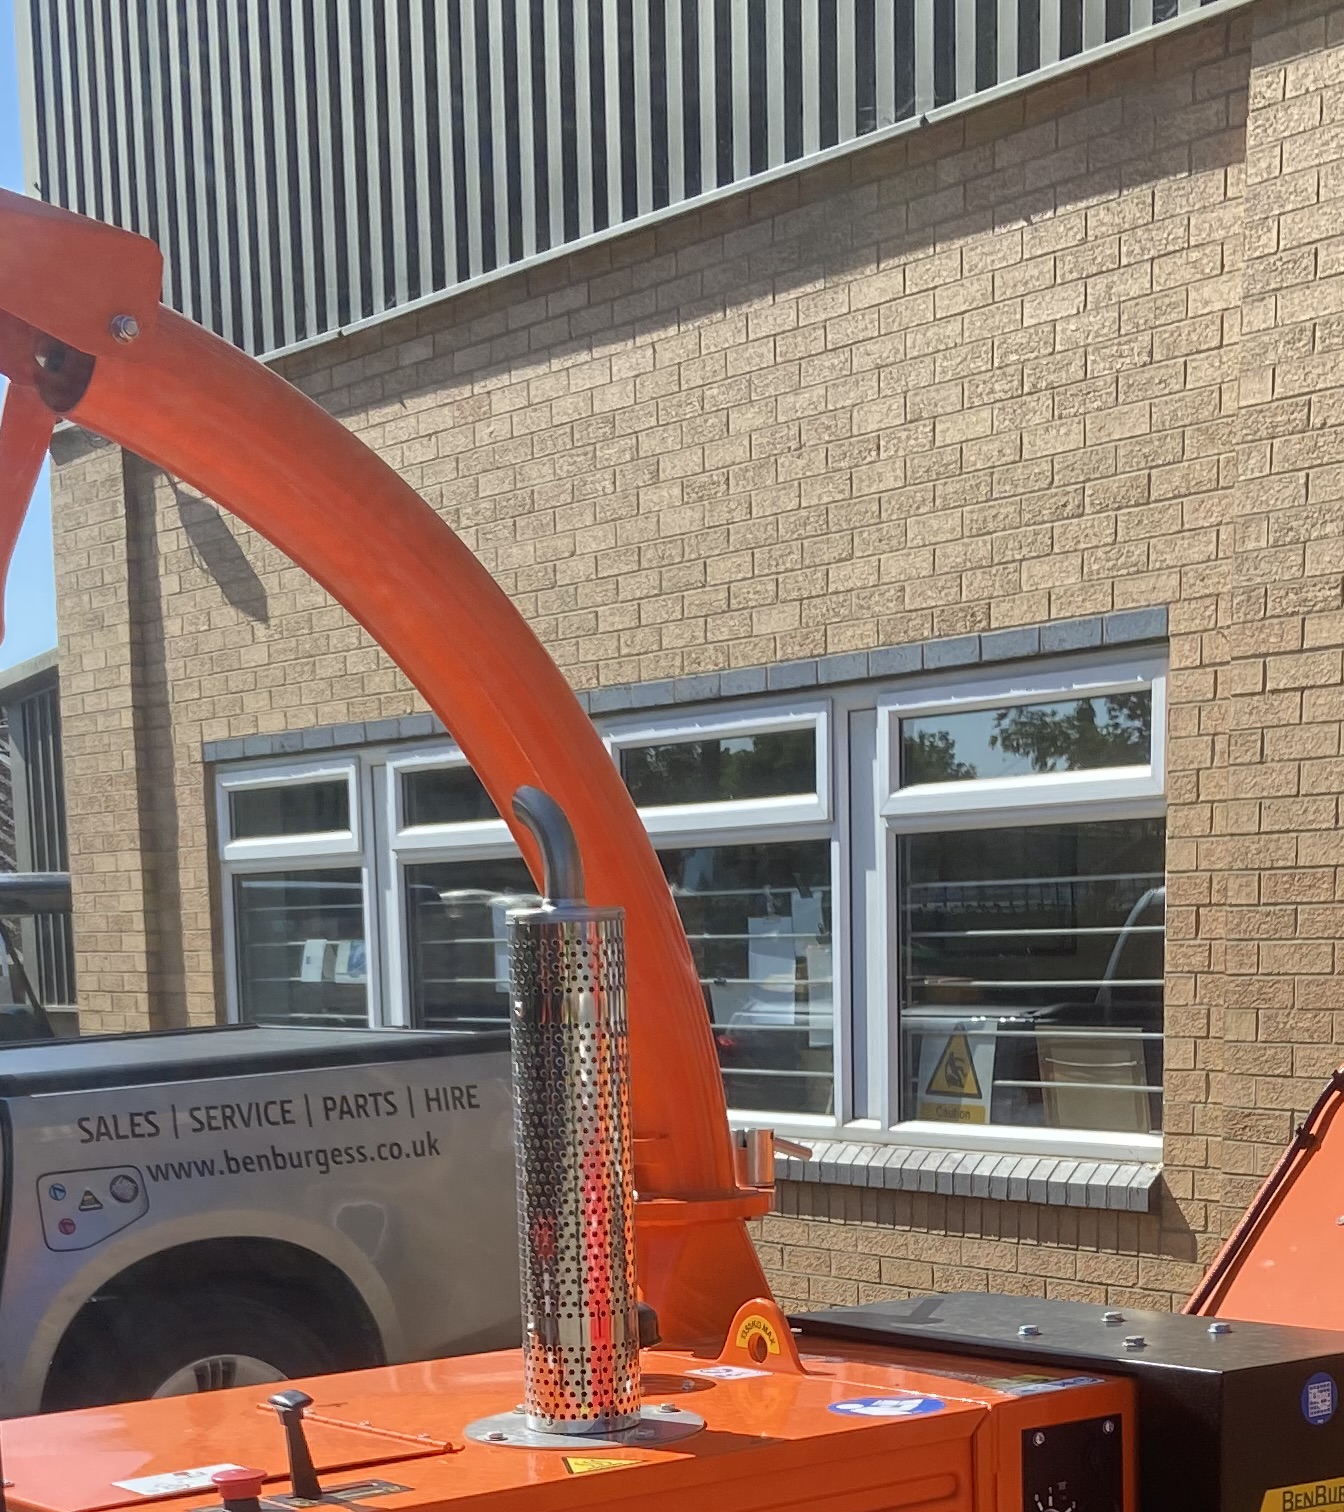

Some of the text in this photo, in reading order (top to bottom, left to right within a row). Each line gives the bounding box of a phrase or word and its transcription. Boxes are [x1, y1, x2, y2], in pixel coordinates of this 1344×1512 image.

[77, 1084, 481, 1144] SALES SERVICE PARTS HIRE
[147, 1131, 441, 1183] www.benburgess.co.uk
